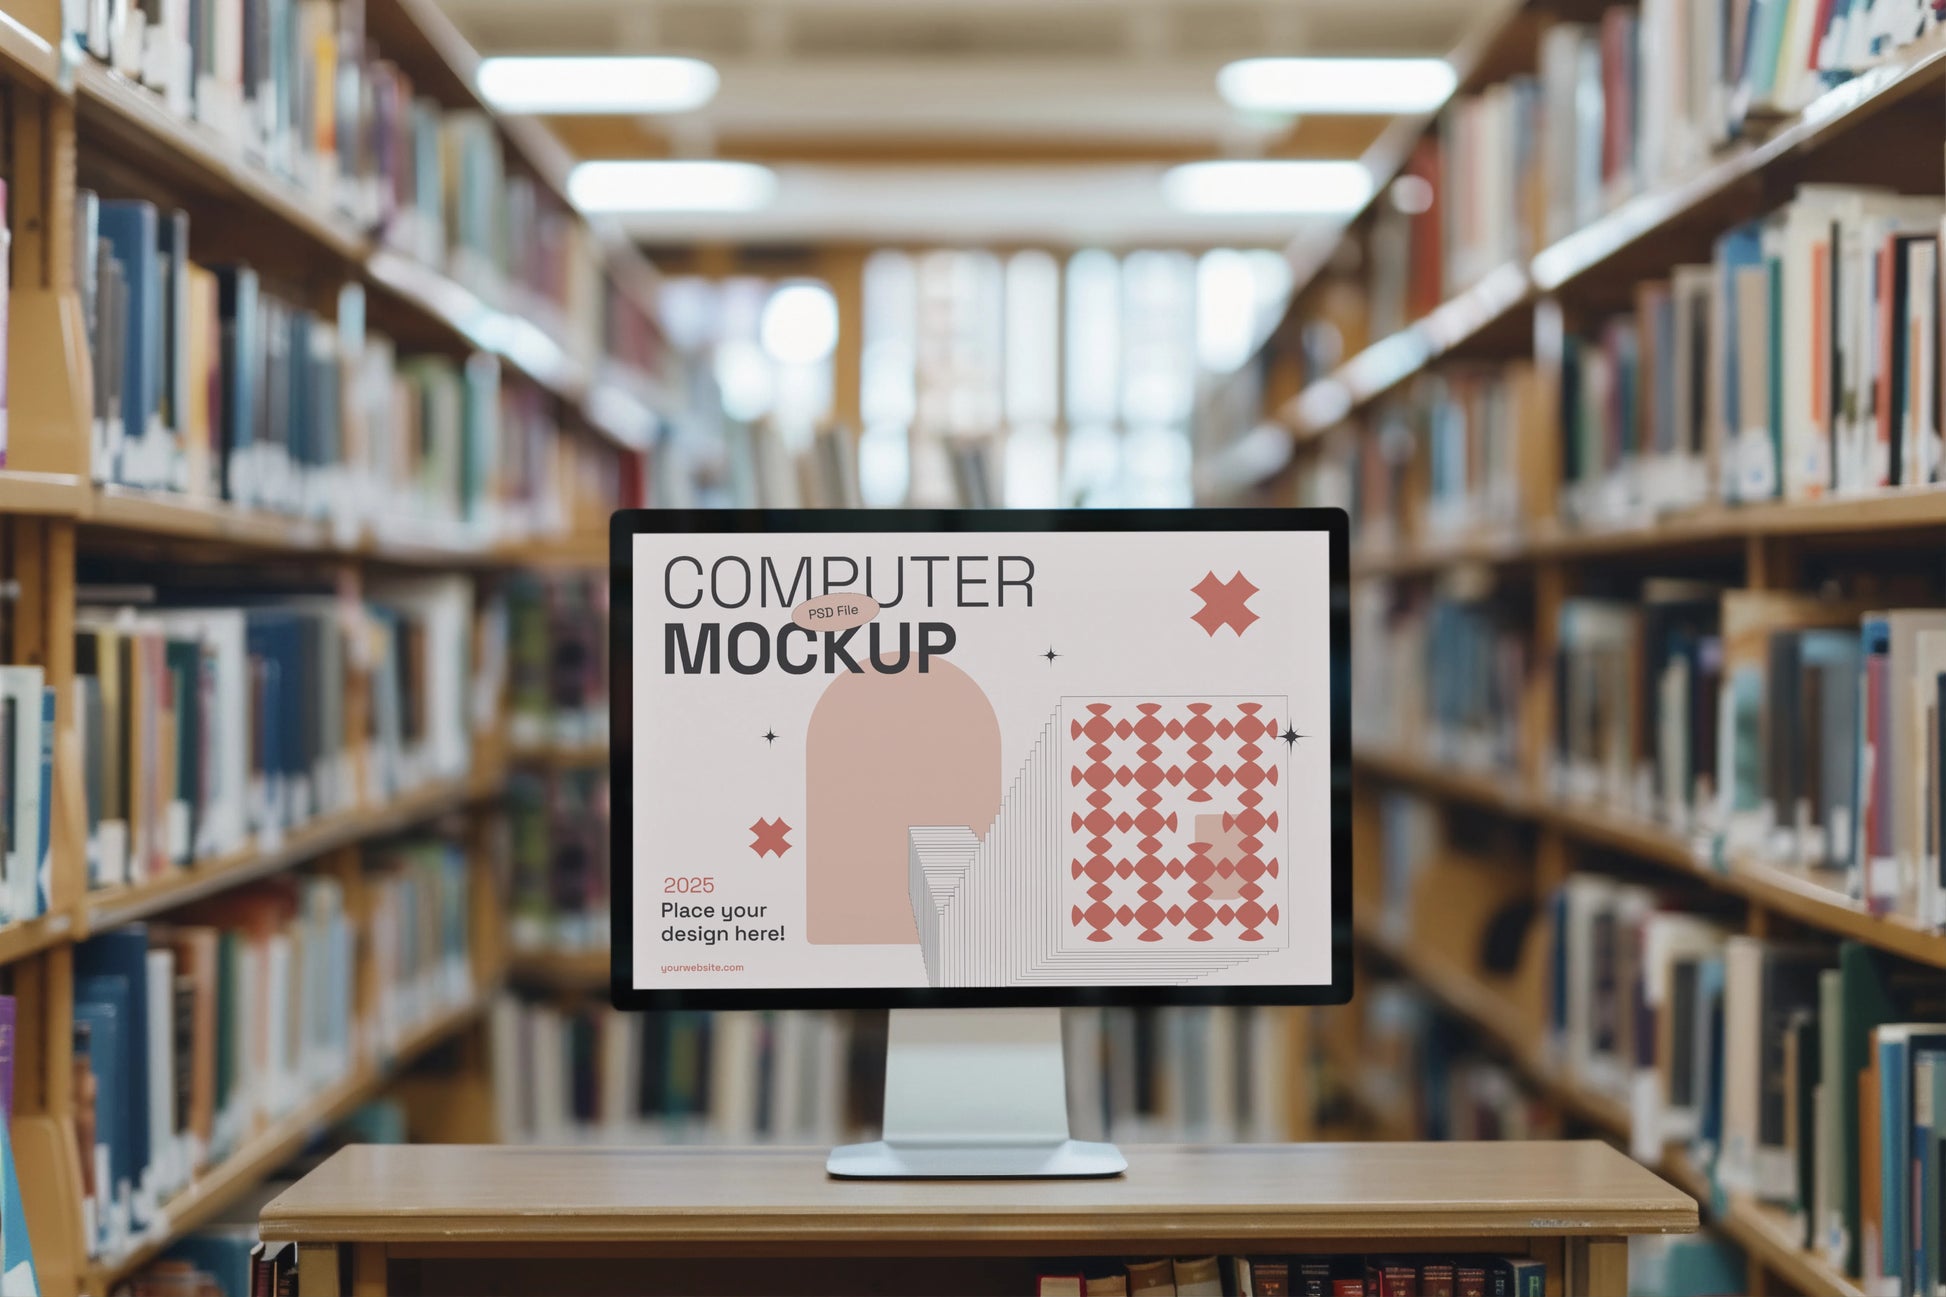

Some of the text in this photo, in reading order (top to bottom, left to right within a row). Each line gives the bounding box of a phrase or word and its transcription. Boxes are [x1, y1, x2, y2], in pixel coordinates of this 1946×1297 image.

[664, 555, 1035, 609] COMPUTER
[808, 604, 859, 620] PSD File
[664, 622, 957, 675] MOCKUP
[664, 877, 714, 894] 2025
[661, 902, 767, 922] Place your
[661, 924, 785, 946] design here!
[660, 963, 744, 974] yourwebsite.com
